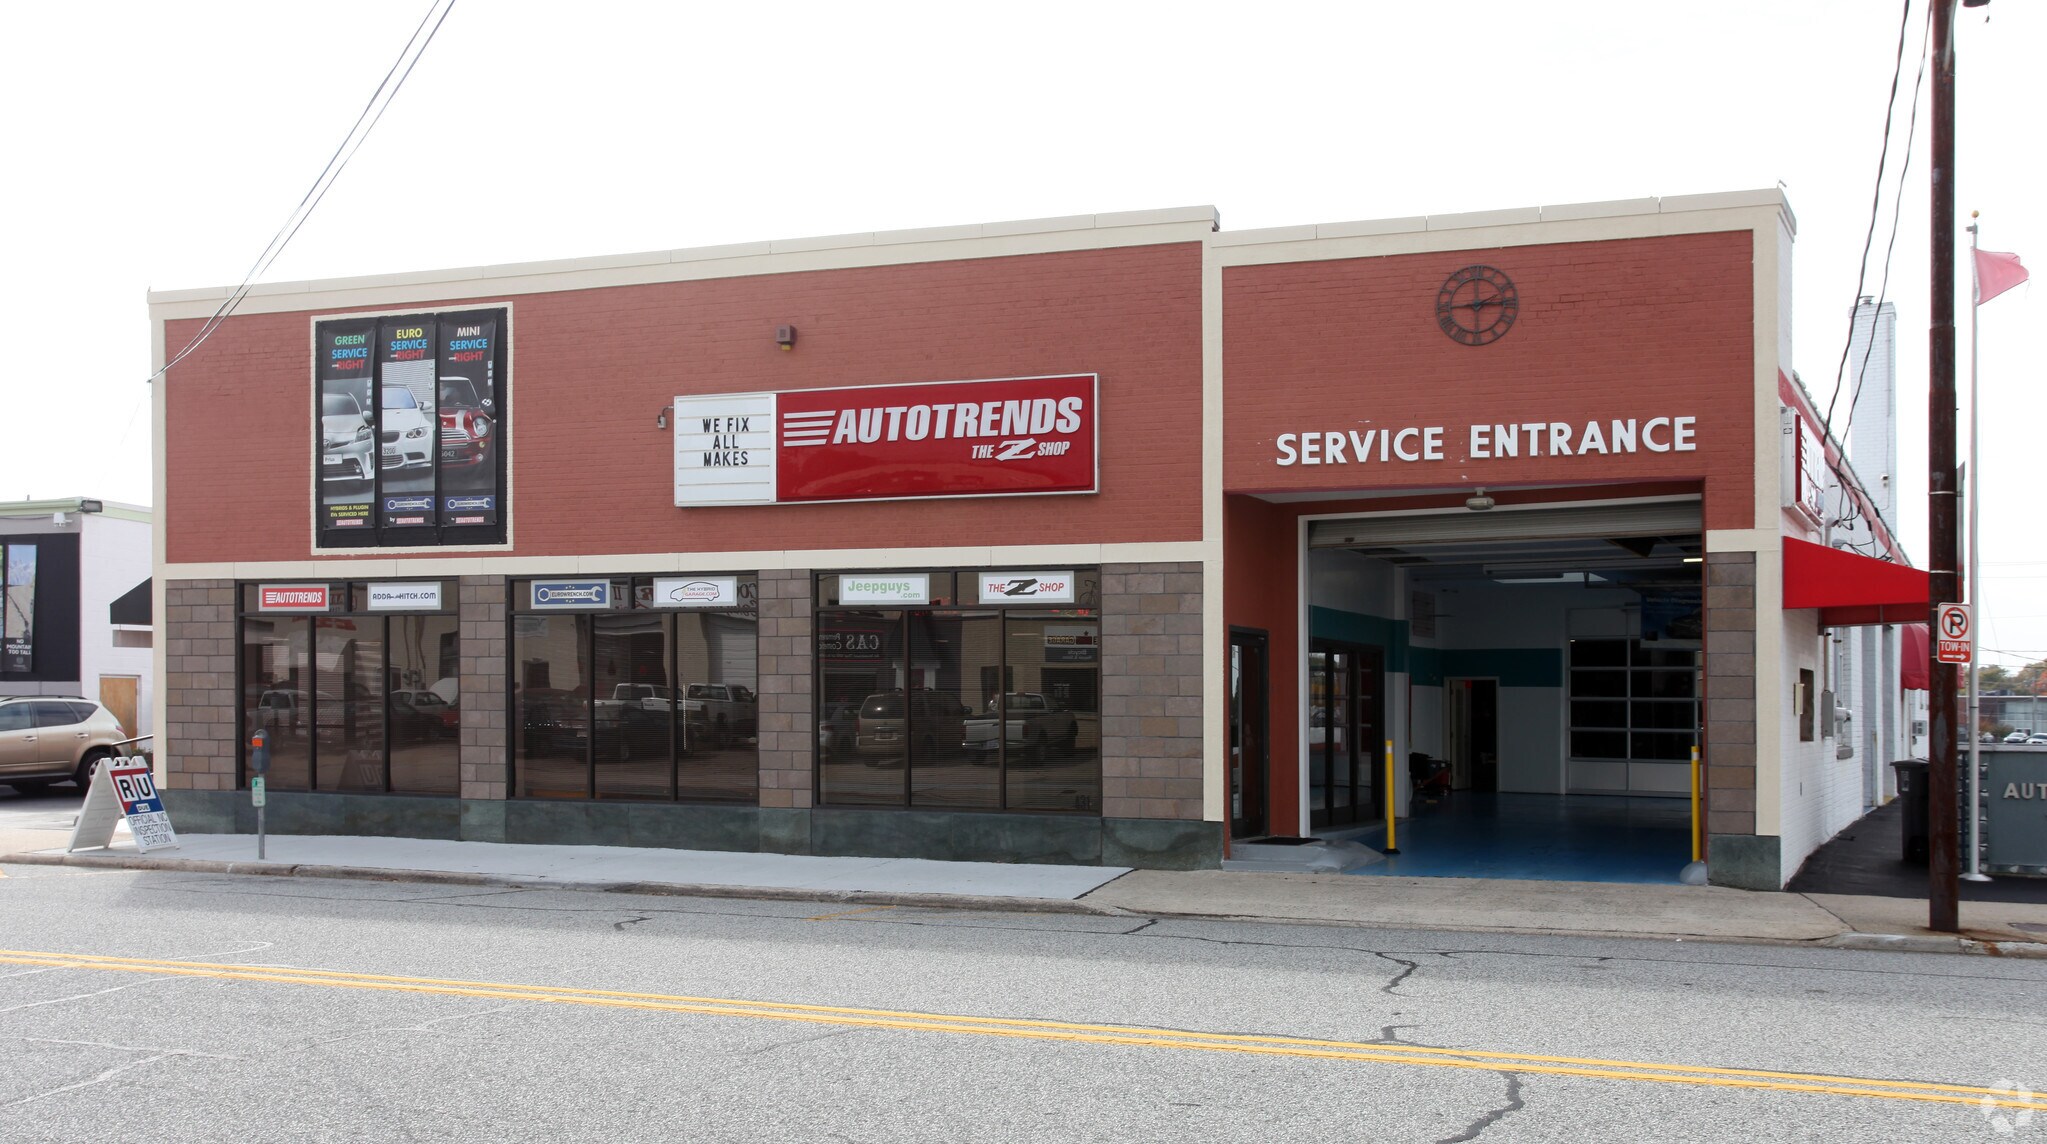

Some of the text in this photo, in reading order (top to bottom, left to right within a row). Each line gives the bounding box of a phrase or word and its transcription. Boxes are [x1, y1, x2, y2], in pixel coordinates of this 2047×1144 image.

[396, 328, 422, 339] EURO
[457, 326, 480, 337] MINI
[334, 334, 365, 346] GREEN
[390, 339, 427, 351] SERVICE
[450, 338, 488, 350] SERVICE
[332, 348, 368, 359] SERVICE
[396, 350, 425, 360] RIGHT
[454, 351, 484, 362] RIGHT
[336, 360, 365, 370] RIGHT
[702, 416, 750, 433] WE FIX
[832, 396, 1082, 445] AUTOTRENDS
[712, 434, 739, 450] ALL
[1276, 416, 1697, 466] SERVICE ENTRANCE
[972, 438, 1071, 461] THE Z SHOP
[703, 450, 748, 467] MAKES
[848, 580, 910, 594] Jeepguys
[988, 578, 1064, 596] THE Z SHOP
[275, 591, 322, 603] AUTOTRENDS
[1940, 642, 1970, 652] TOW-IN
[129, 813, 168, 826] OFFICIAL NC
[134, 823, 172, 835] INSPECTION
[143, 834, 172, 845] STATION
